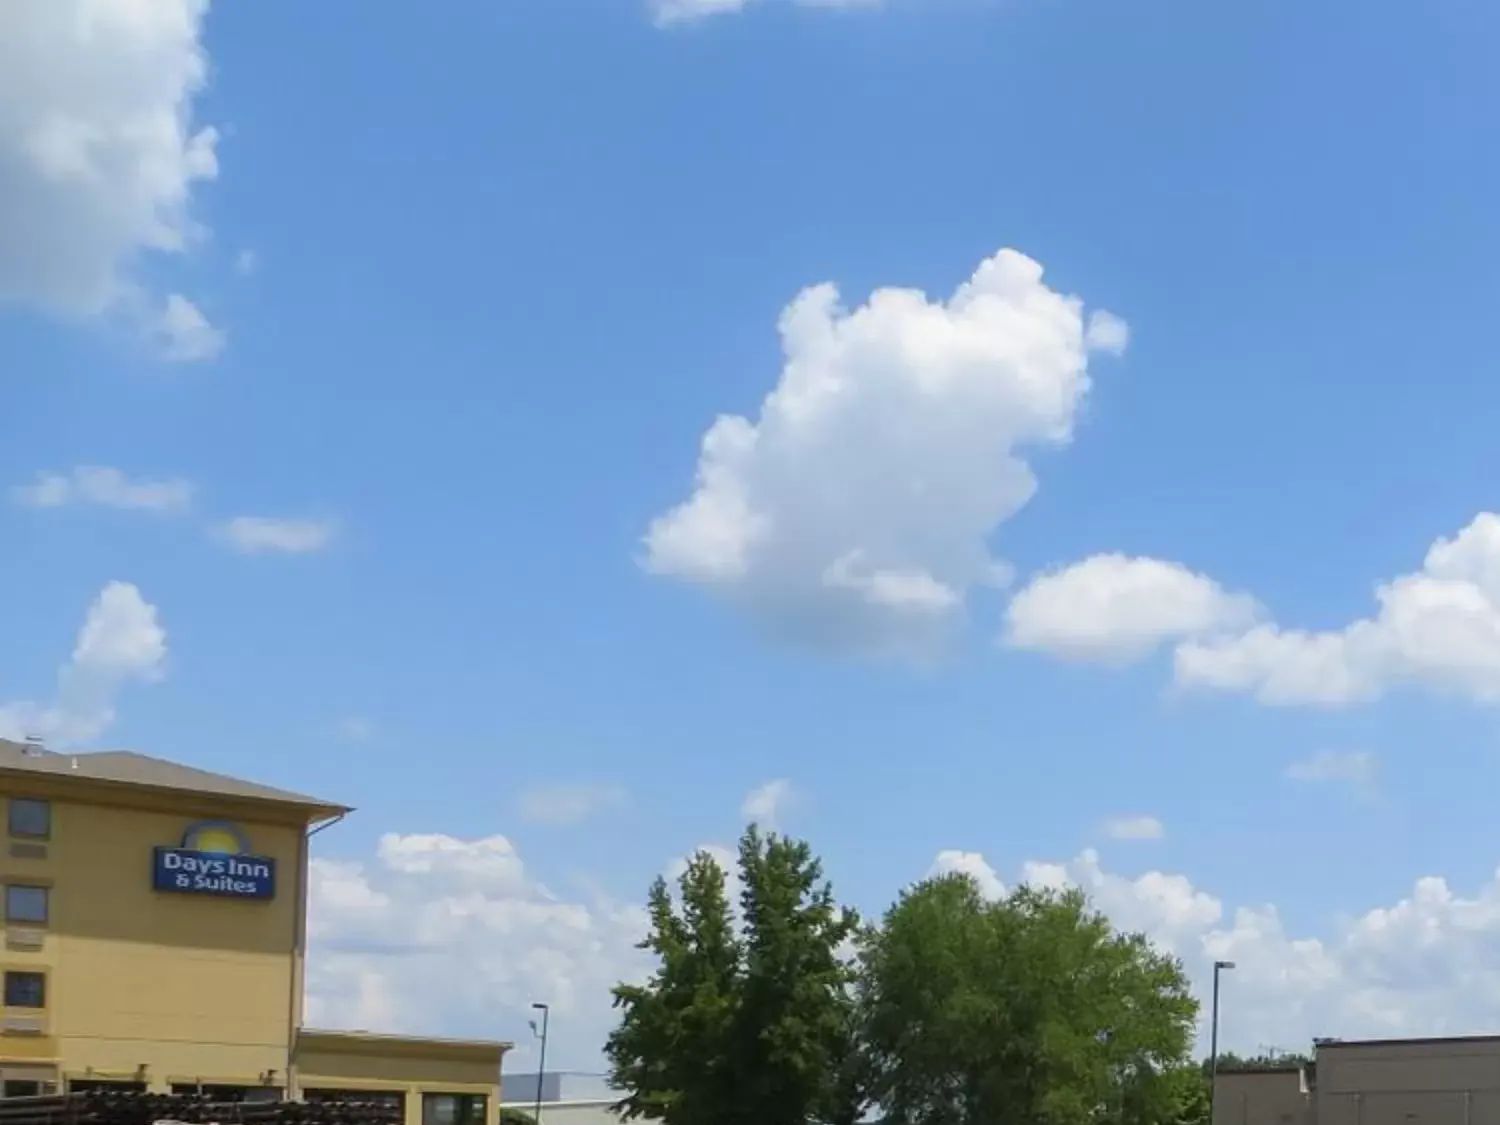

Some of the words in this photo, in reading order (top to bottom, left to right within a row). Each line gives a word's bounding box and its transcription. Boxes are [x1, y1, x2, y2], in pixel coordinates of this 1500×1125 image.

[164, 853, 224, 874] Days
[228, 859, 269, 878] Inn
[175, 874, 189, 887] &
[194, 875, 256, 893] Suites
